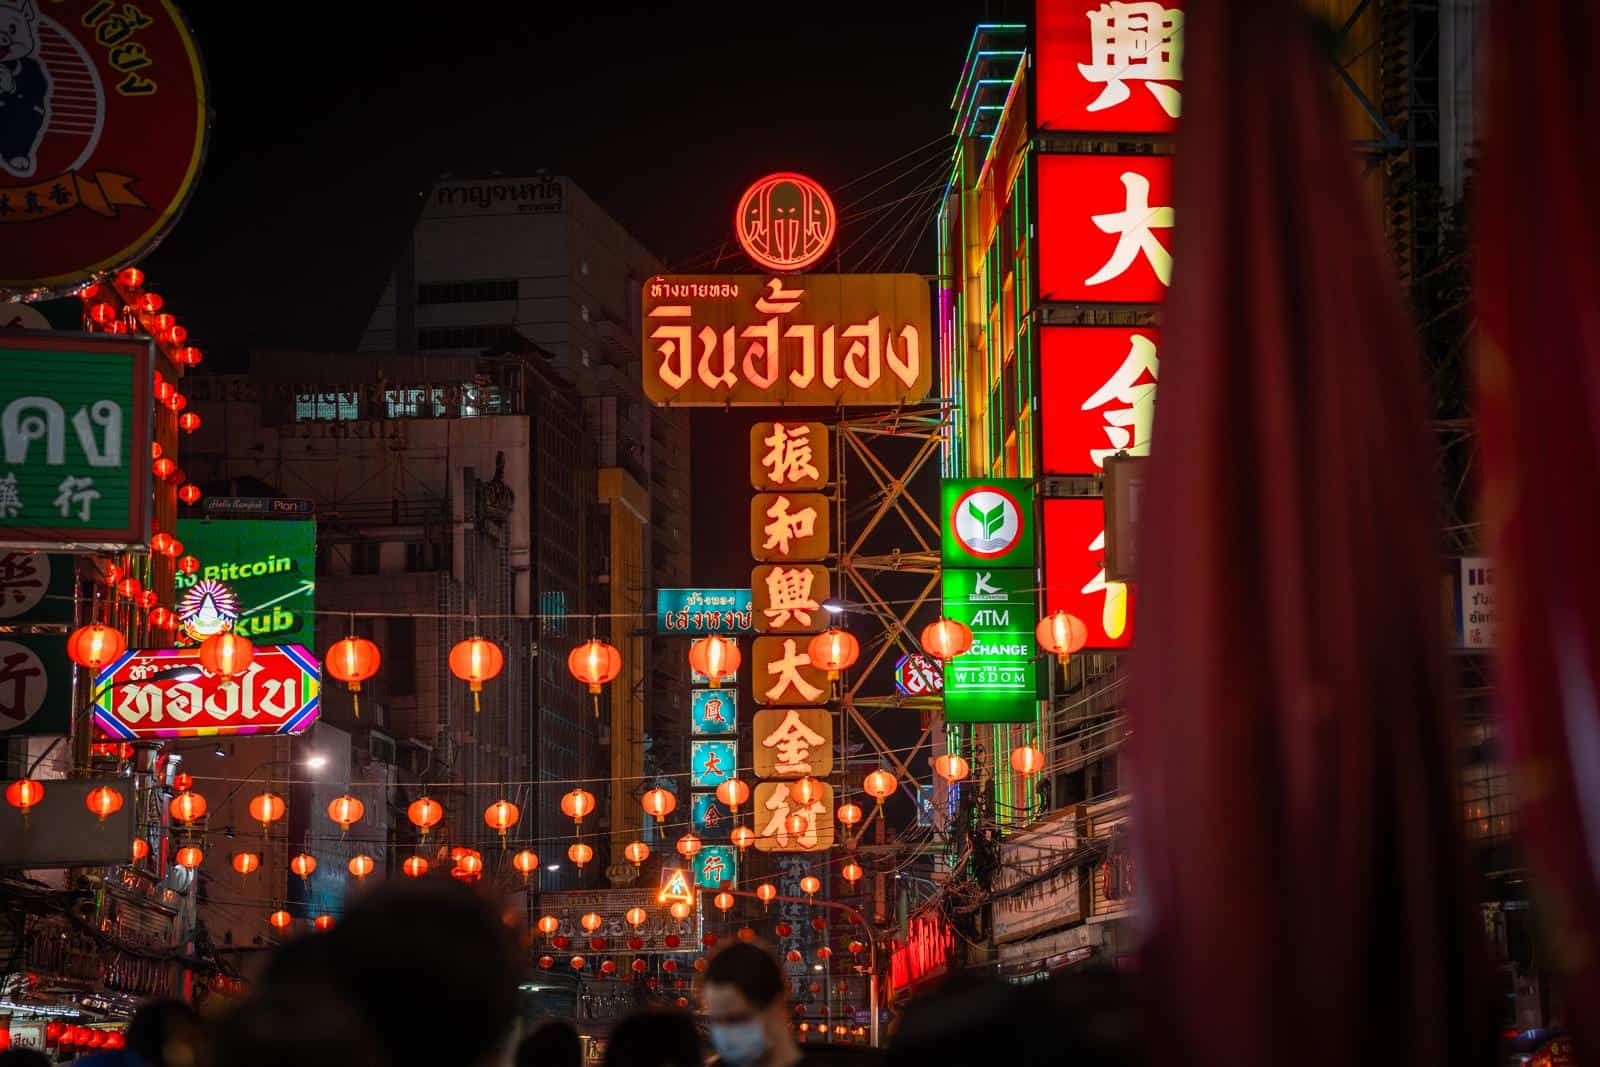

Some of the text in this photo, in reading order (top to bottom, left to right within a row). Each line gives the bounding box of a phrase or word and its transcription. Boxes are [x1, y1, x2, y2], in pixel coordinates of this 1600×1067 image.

[650, 275, 739, 298] ห้างขายทอง
[648, 276, 921, 391] จินฮั้วเฮง
[1076, 0, 1184, 642] 興大金
[1, 395, 123, 468] คง
[204, 555, 292, 583] Bitcoin
[760, 421, 826, 849] 振和興大金行
[971, 609, 1009, 626] ATM
[963, 644, 1029, 656] CHANGE
[955, 672, 1025, 683] WISDOM
[703, 699, 726, 881] 鳳大金行
